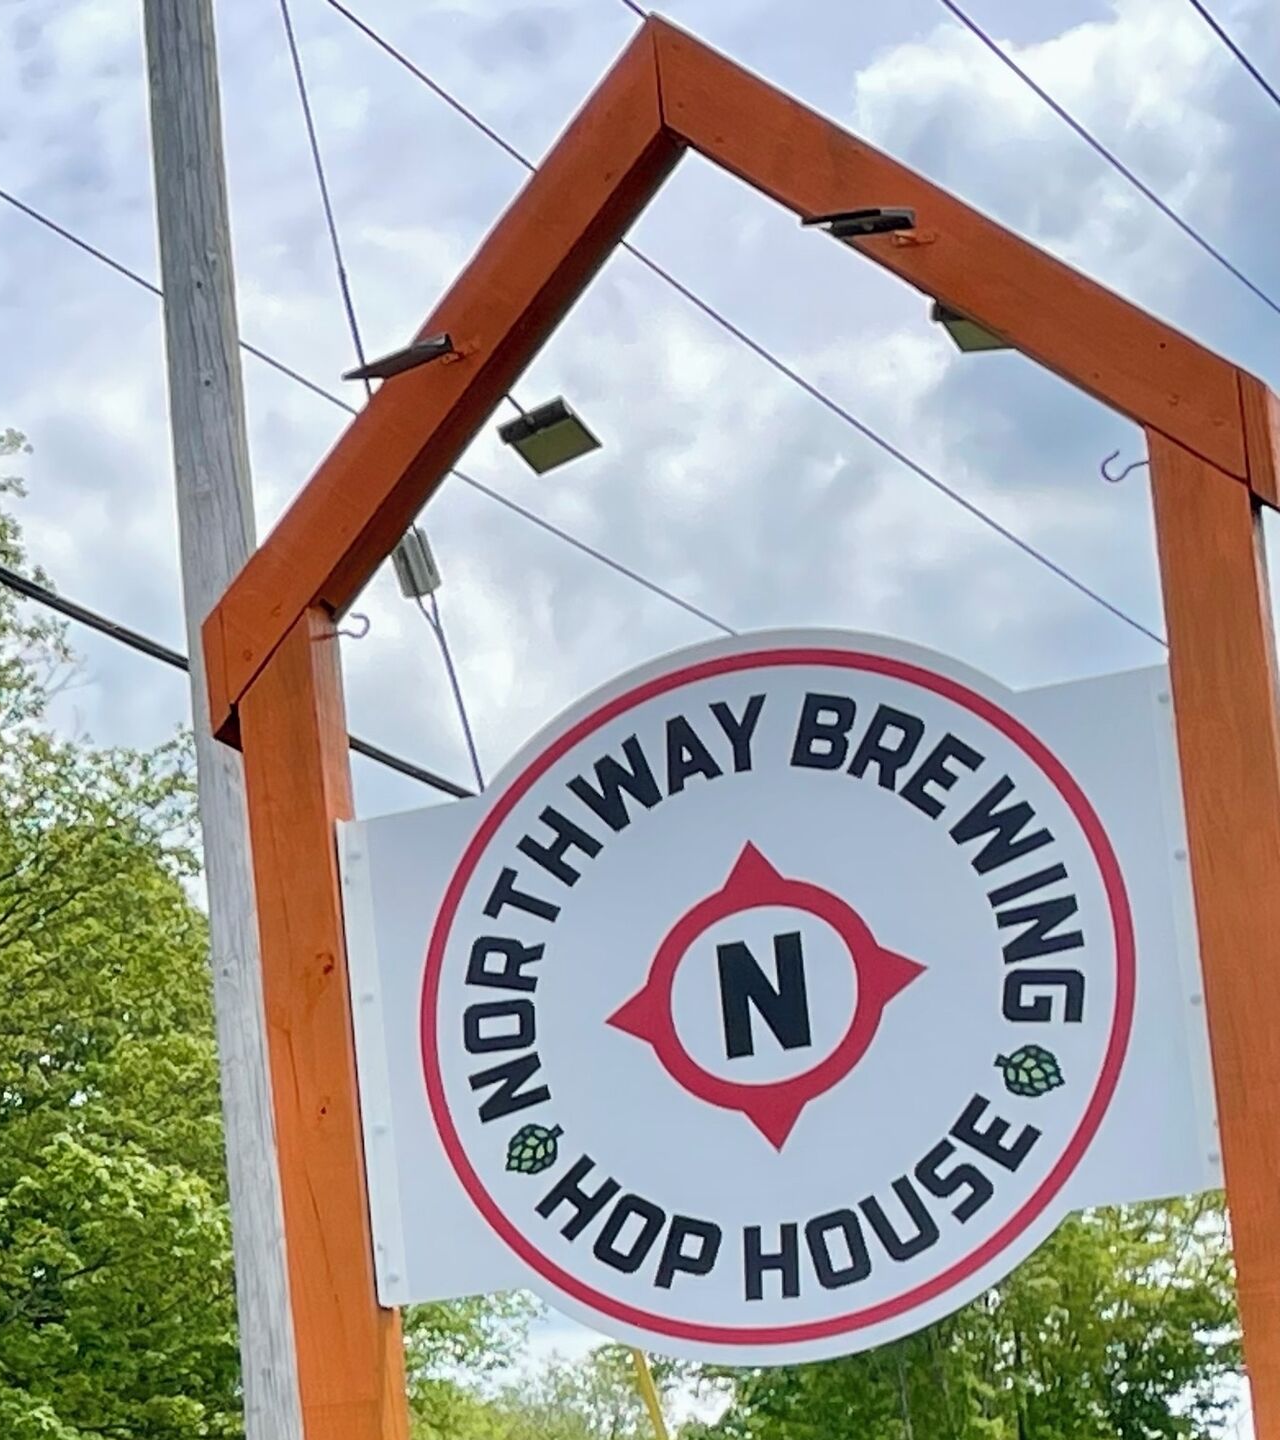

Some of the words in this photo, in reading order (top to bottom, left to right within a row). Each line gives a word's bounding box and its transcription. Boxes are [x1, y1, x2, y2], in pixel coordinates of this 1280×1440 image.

[462, 692, 768, 1125] NORTHWAY
[790, 692, 1086, 1099] BREWING
[716, 931, 813, 1060] N
[534, 1154, 722, 1290] HOP
[743, 1093, 1042, 1302] HOUSE
